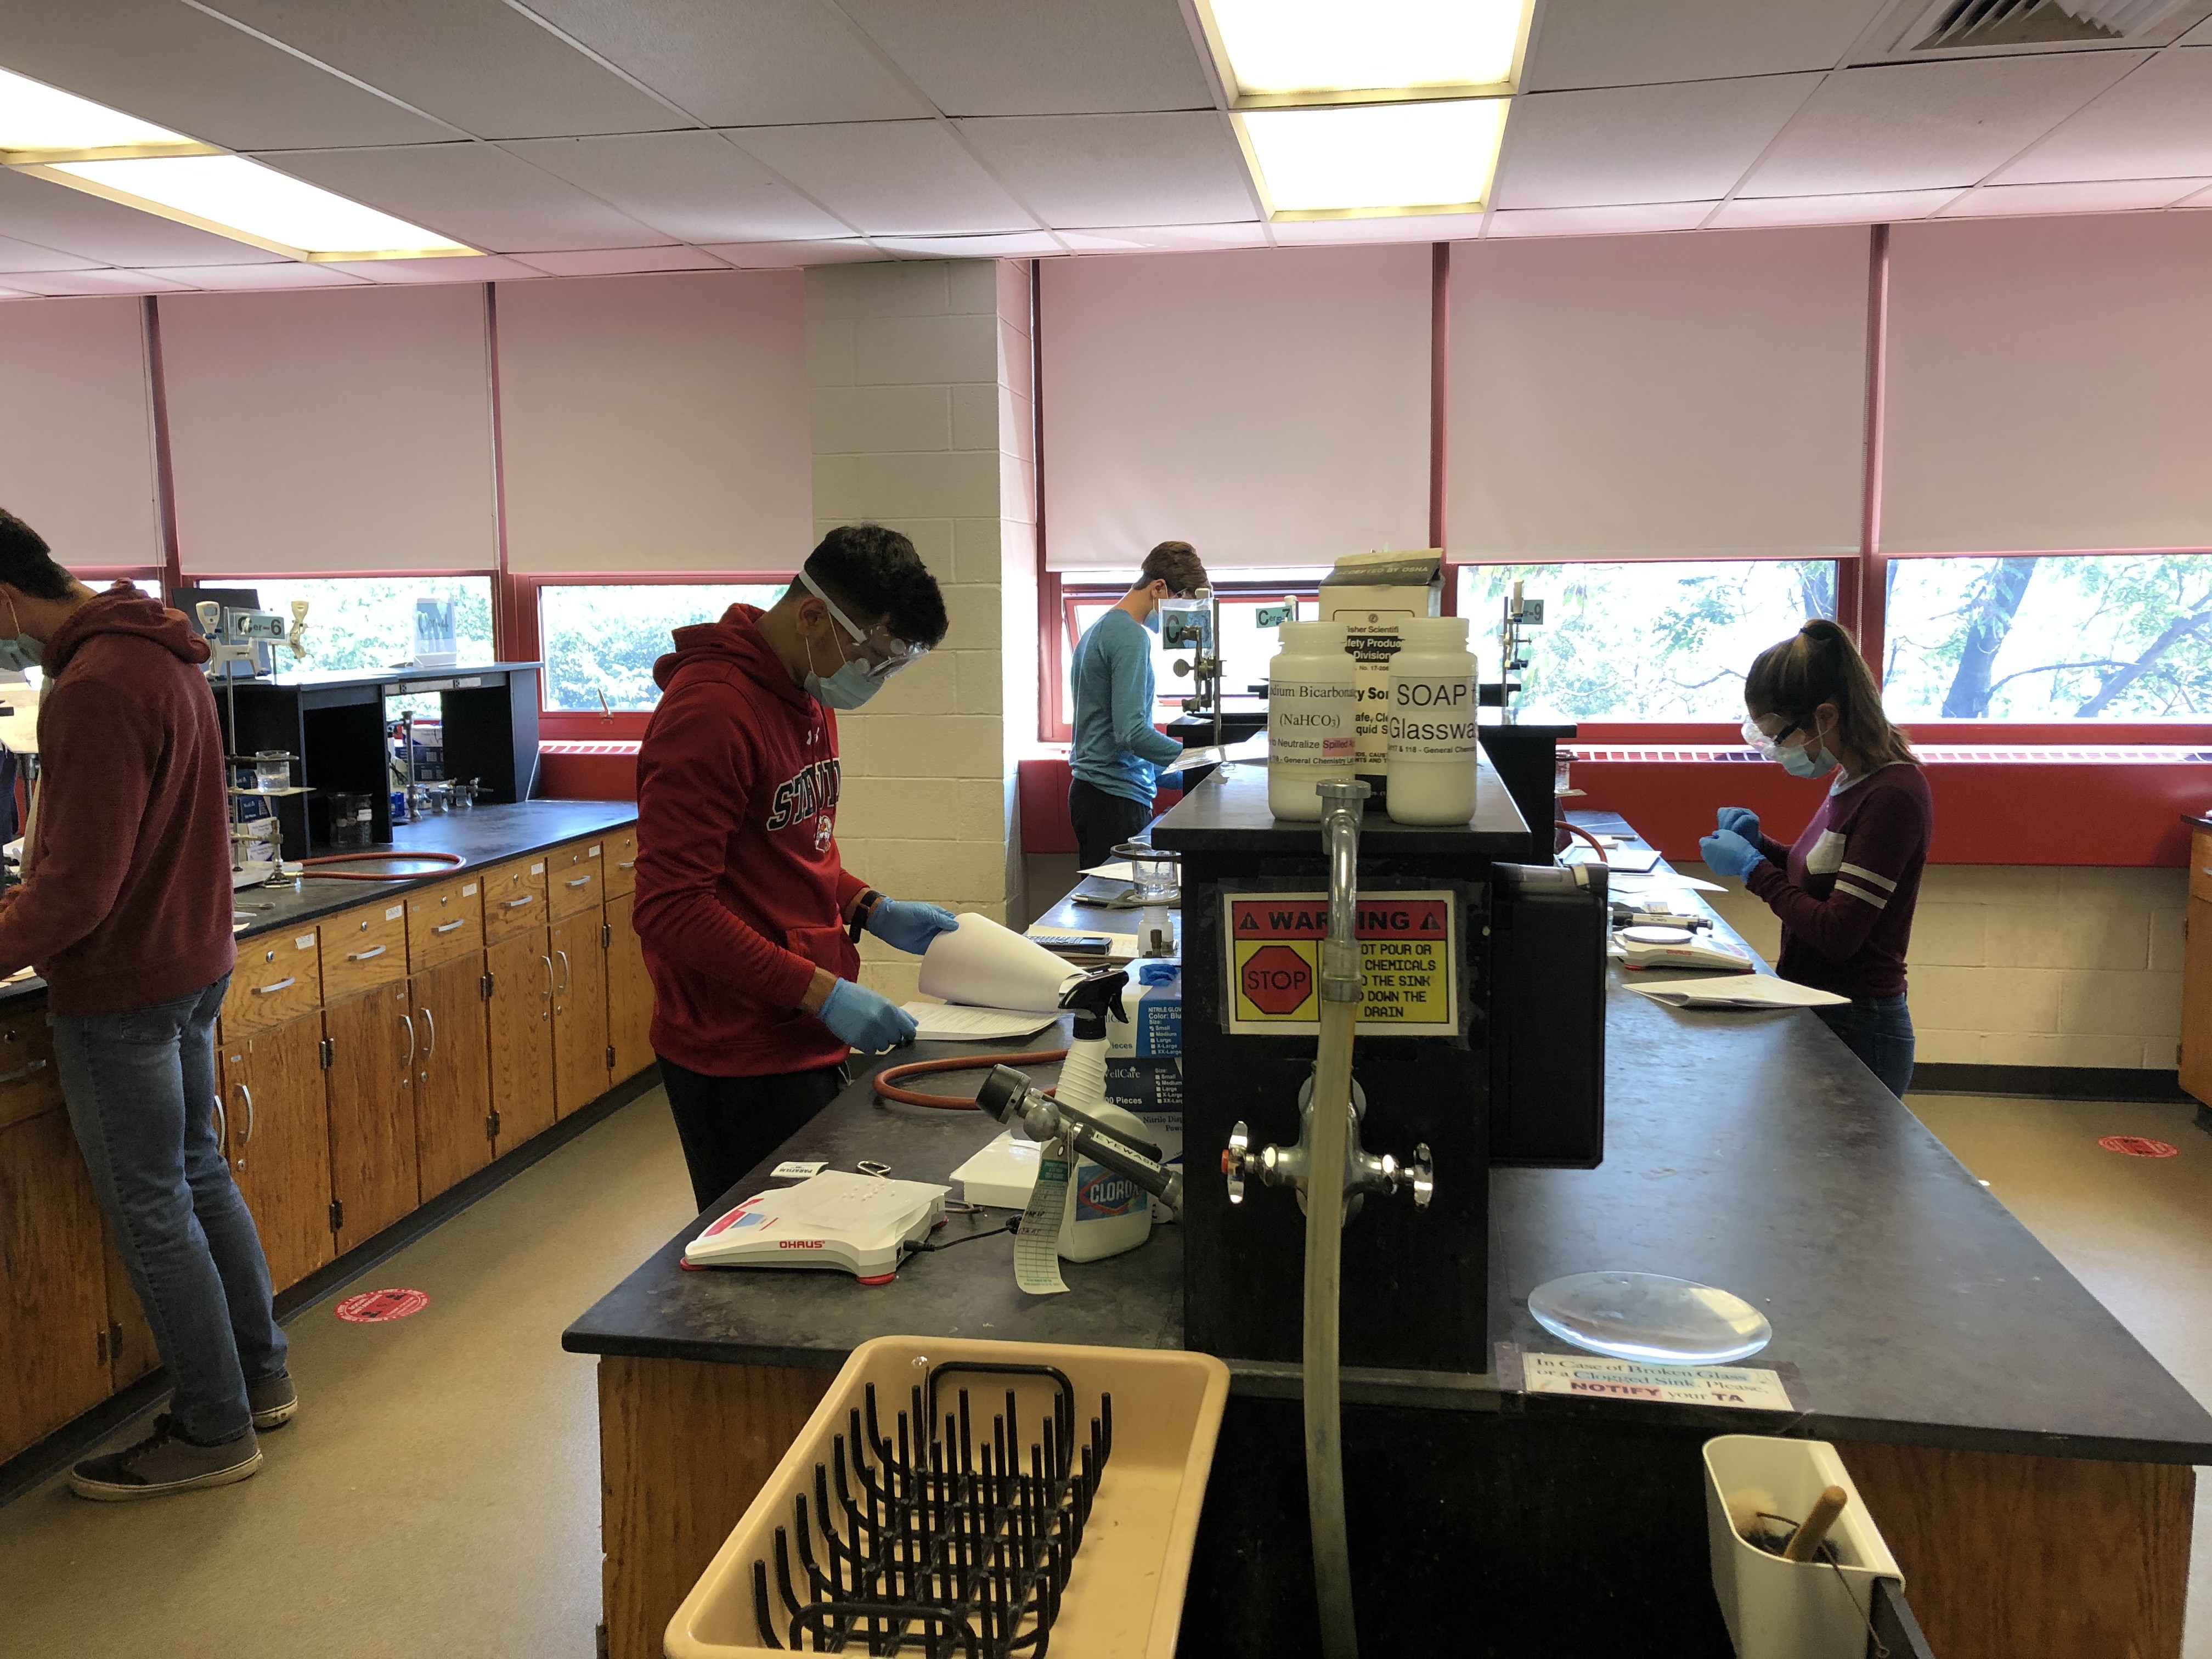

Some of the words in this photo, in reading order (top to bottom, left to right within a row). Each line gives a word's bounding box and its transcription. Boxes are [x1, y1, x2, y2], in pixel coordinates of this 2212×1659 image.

[1347, 639, 1365, 649] fety
[1367, 639, 1402, 647] Produc
[1353, 651, 1391, 659] Division
[1269, 685, 1295, 697] odium
[1397, 684, 1467, 706] SOAP
[1355, 713, 1374, 723] afe,
[1356, 725, 1378, 736] quid
[1390, 716, 1476, 740] Glasswa
[1277, 738, 1320, 749] Neutralize
[1315, 757, 1346, 766] Chemistry
[1267, 911, 1410, 930] WARING
[1361, 944, 1376, 955] OT
[1380, 944, 1412, 955] POUR
[1415, 944, 1432, 955] OR
[1365, 960, 1436, 971] CHEMICALS
[1248, 970, 1306, 990] STOP
[1372, 975, 1395, 986] THE
[1398, 975, 1431, 987] SINK
[1368, 990, 1399, 1002] DOWN
[1403, 991, 1427, 1002] THE
[1364, 1006, 1404, 1017] DRAIN
[1116, 1096, 1143, 1104] Pieces
[1143, 1115, 1166, 1124] Nitrile
[1096, 1133, 1160, 1170] EYEWASH
[779, 1240, 823, 1249] OHAUS
[1537, 1358, 1555, 1367] In
[1559, 1360, 1602, 1370] Case
[1628, 1365, 1692, 1378] Broken
[1696, 1370, 1747, 1381] Glass
[1573, 1372, 1649, 1384] Clogged
[1571, 1381, 1661, 1397] NOTIFY
[1668, 1391, 1708, 1401] your
[1711, 1390, 1746, 1404] TA
